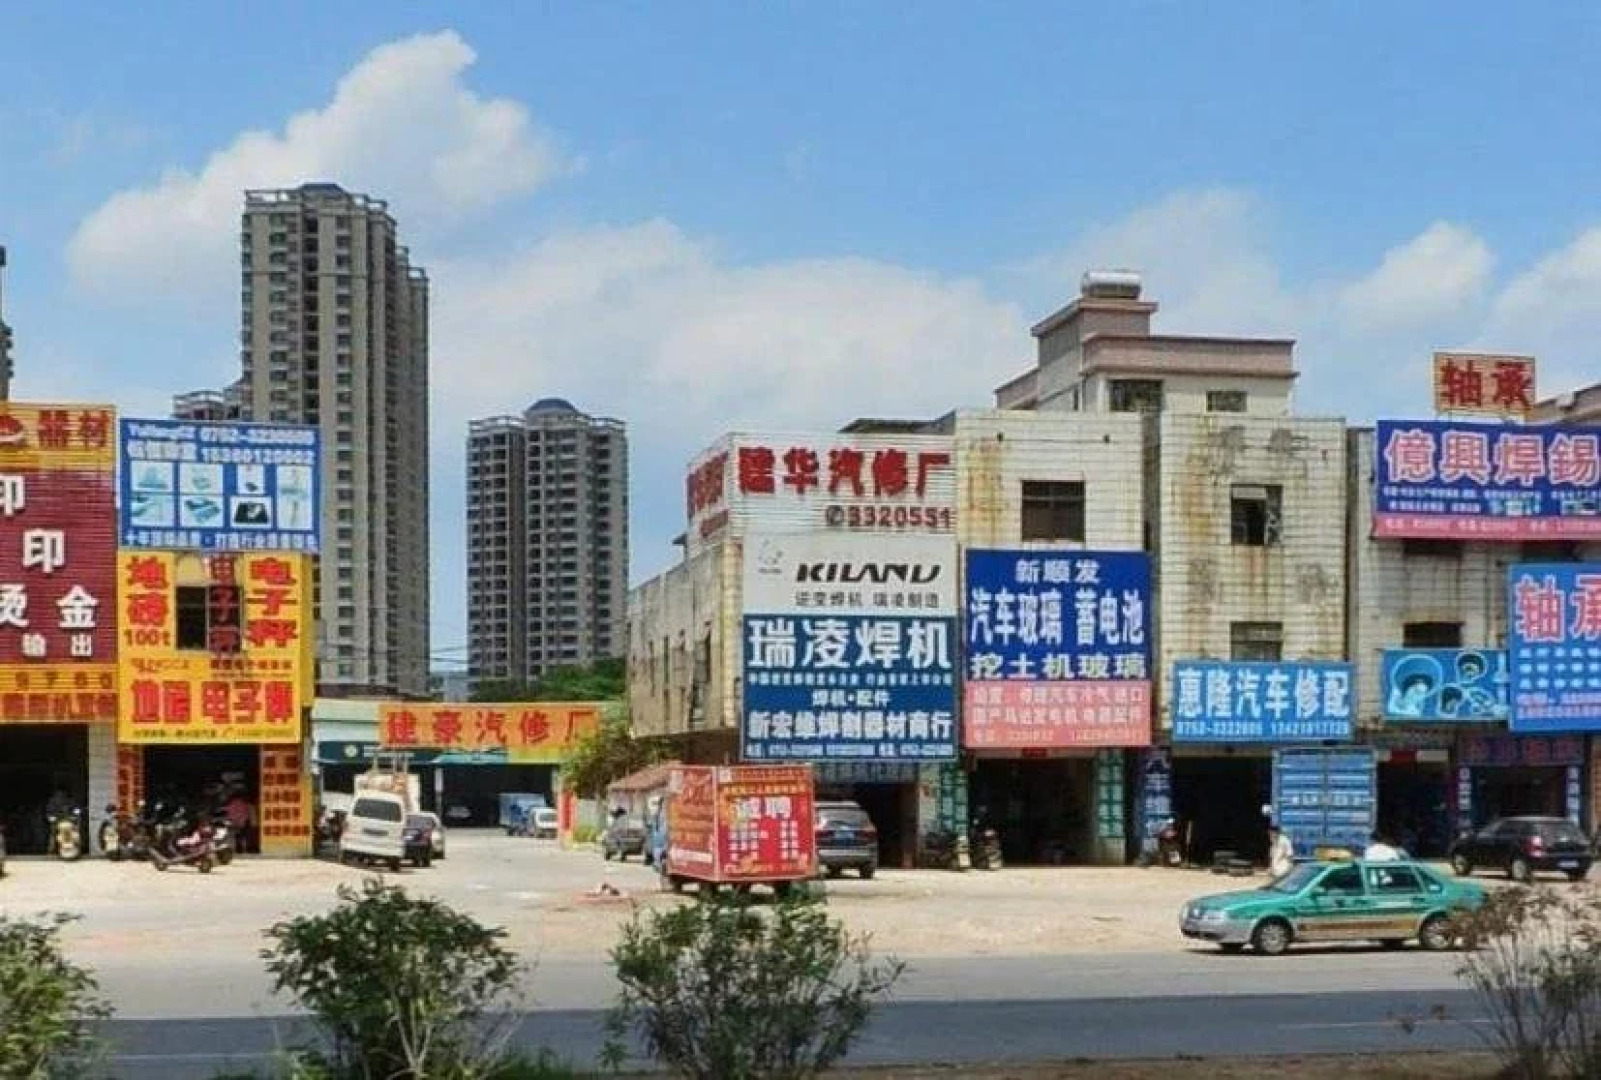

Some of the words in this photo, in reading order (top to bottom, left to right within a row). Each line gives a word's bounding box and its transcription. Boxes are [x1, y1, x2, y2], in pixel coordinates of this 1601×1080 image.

[1440, 358, 1532, 409] 轴承
[738, 446, 950, 497] 建华汽修厂
[22, 528, 65, 574] 印
[1015, 558, 1100, 584] 新顺发
[970, 586, 1063, 646] 汽车玻璃
[1074, 586, 1145, 645] 蓄电池
[748, 617, 952, 669] 瑞凌焊机
[970, 652, 1146, 679] 挖土机玻璃
[386, 710, 595, 745] 建豪汽修厂
